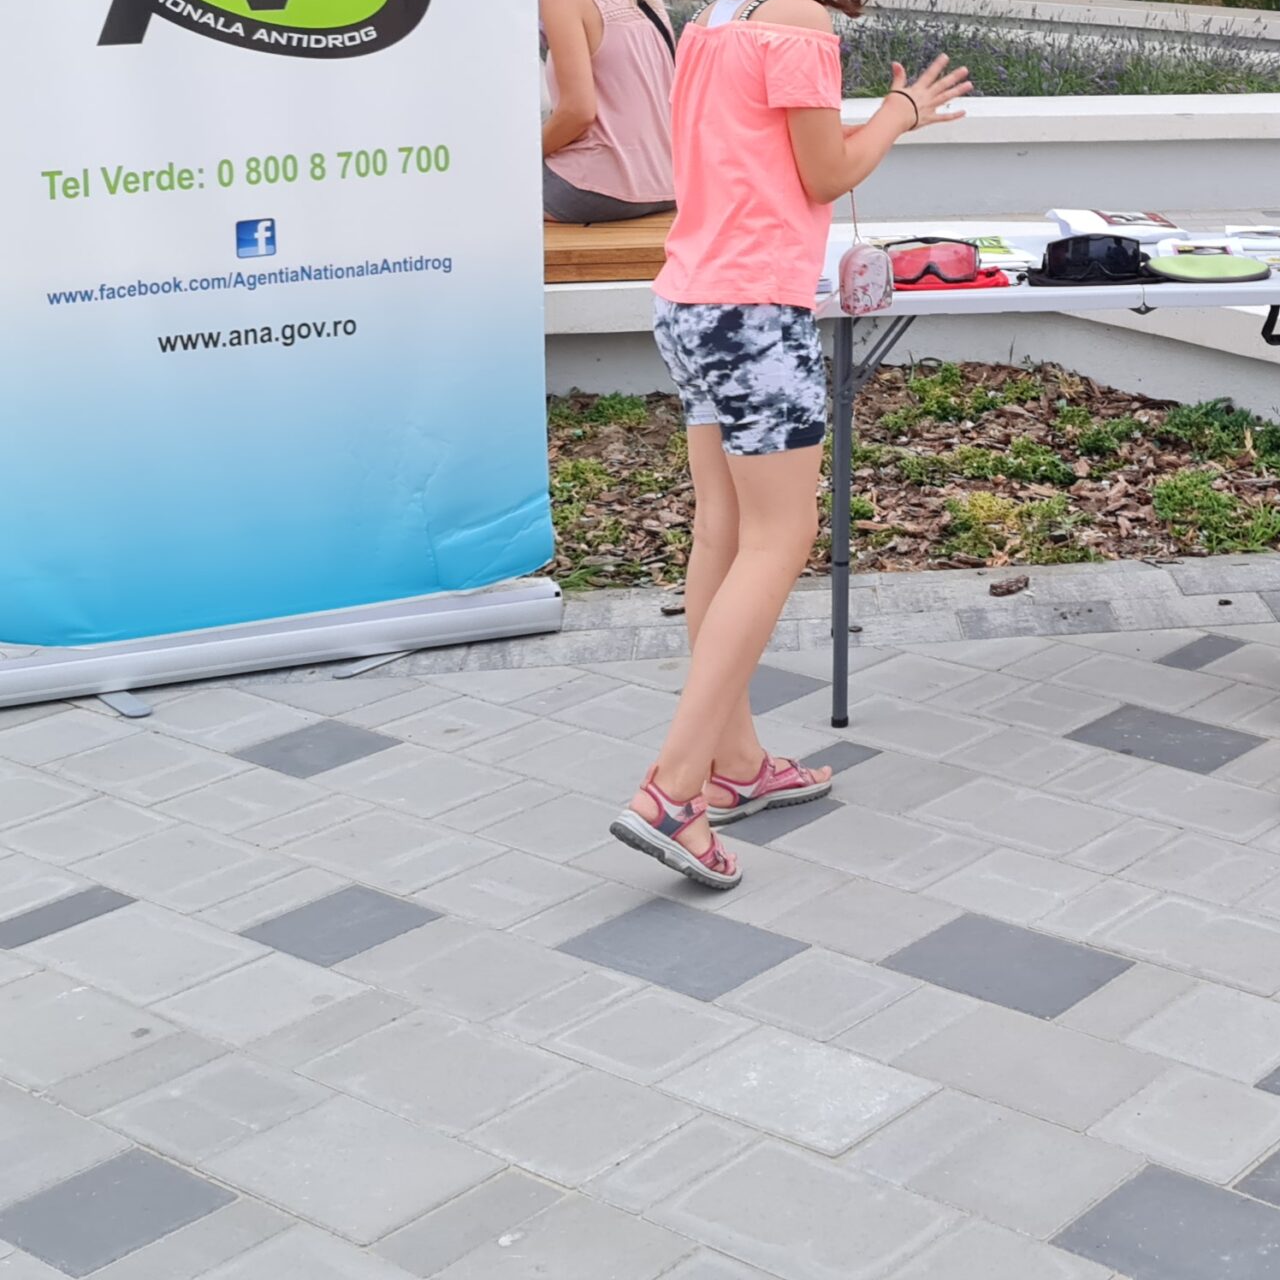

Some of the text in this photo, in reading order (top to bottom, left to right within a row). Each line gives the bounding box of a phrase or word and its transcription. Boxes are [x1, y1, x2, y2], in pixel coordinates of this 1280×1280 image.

[251, 24, 378, 50] ANTIDROG
[41, 144, 451, 201] Tel Verde: 0 800 8 700 700
[47, 255, 453, 306] www.facebook.com/AgentiaNationalaAntidrog
[157, 318, 358, 354] www.ana.gov.ro
